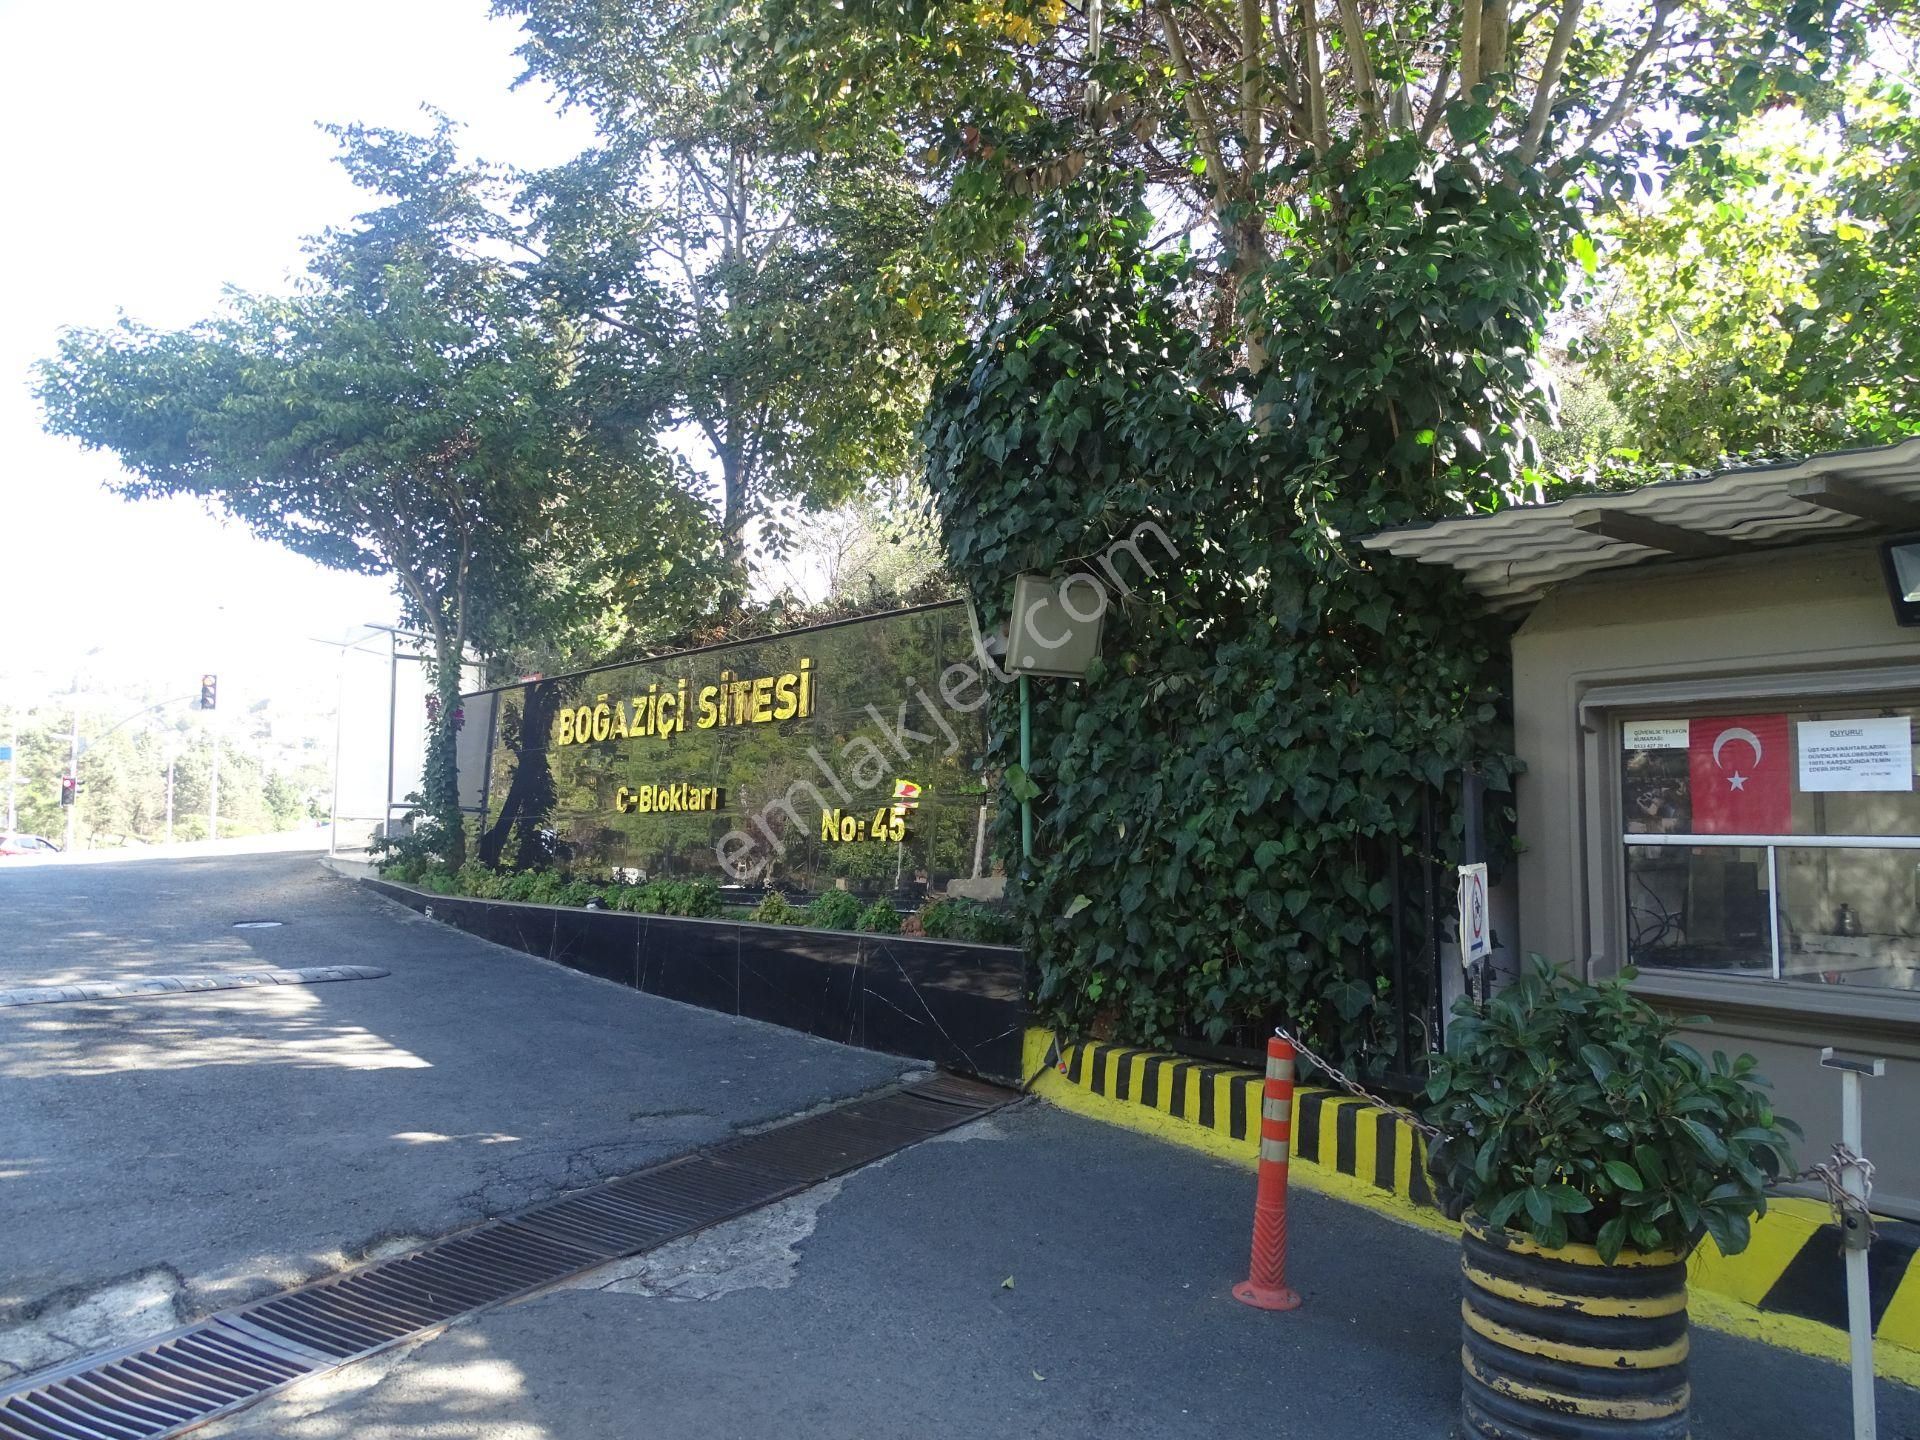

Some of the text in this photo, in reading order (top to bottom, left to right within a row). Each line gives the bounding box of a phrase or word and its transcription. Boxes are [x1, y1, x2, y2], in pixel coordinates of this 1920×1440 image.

[557, 658, 814, 746] BOĞAZİÇİ SİTESİ
[1829, 729, 1864, 738] DUYURU!
[615, 783, 718, 815] C-Blokları
[820, 807, 907, 842] No: 45
